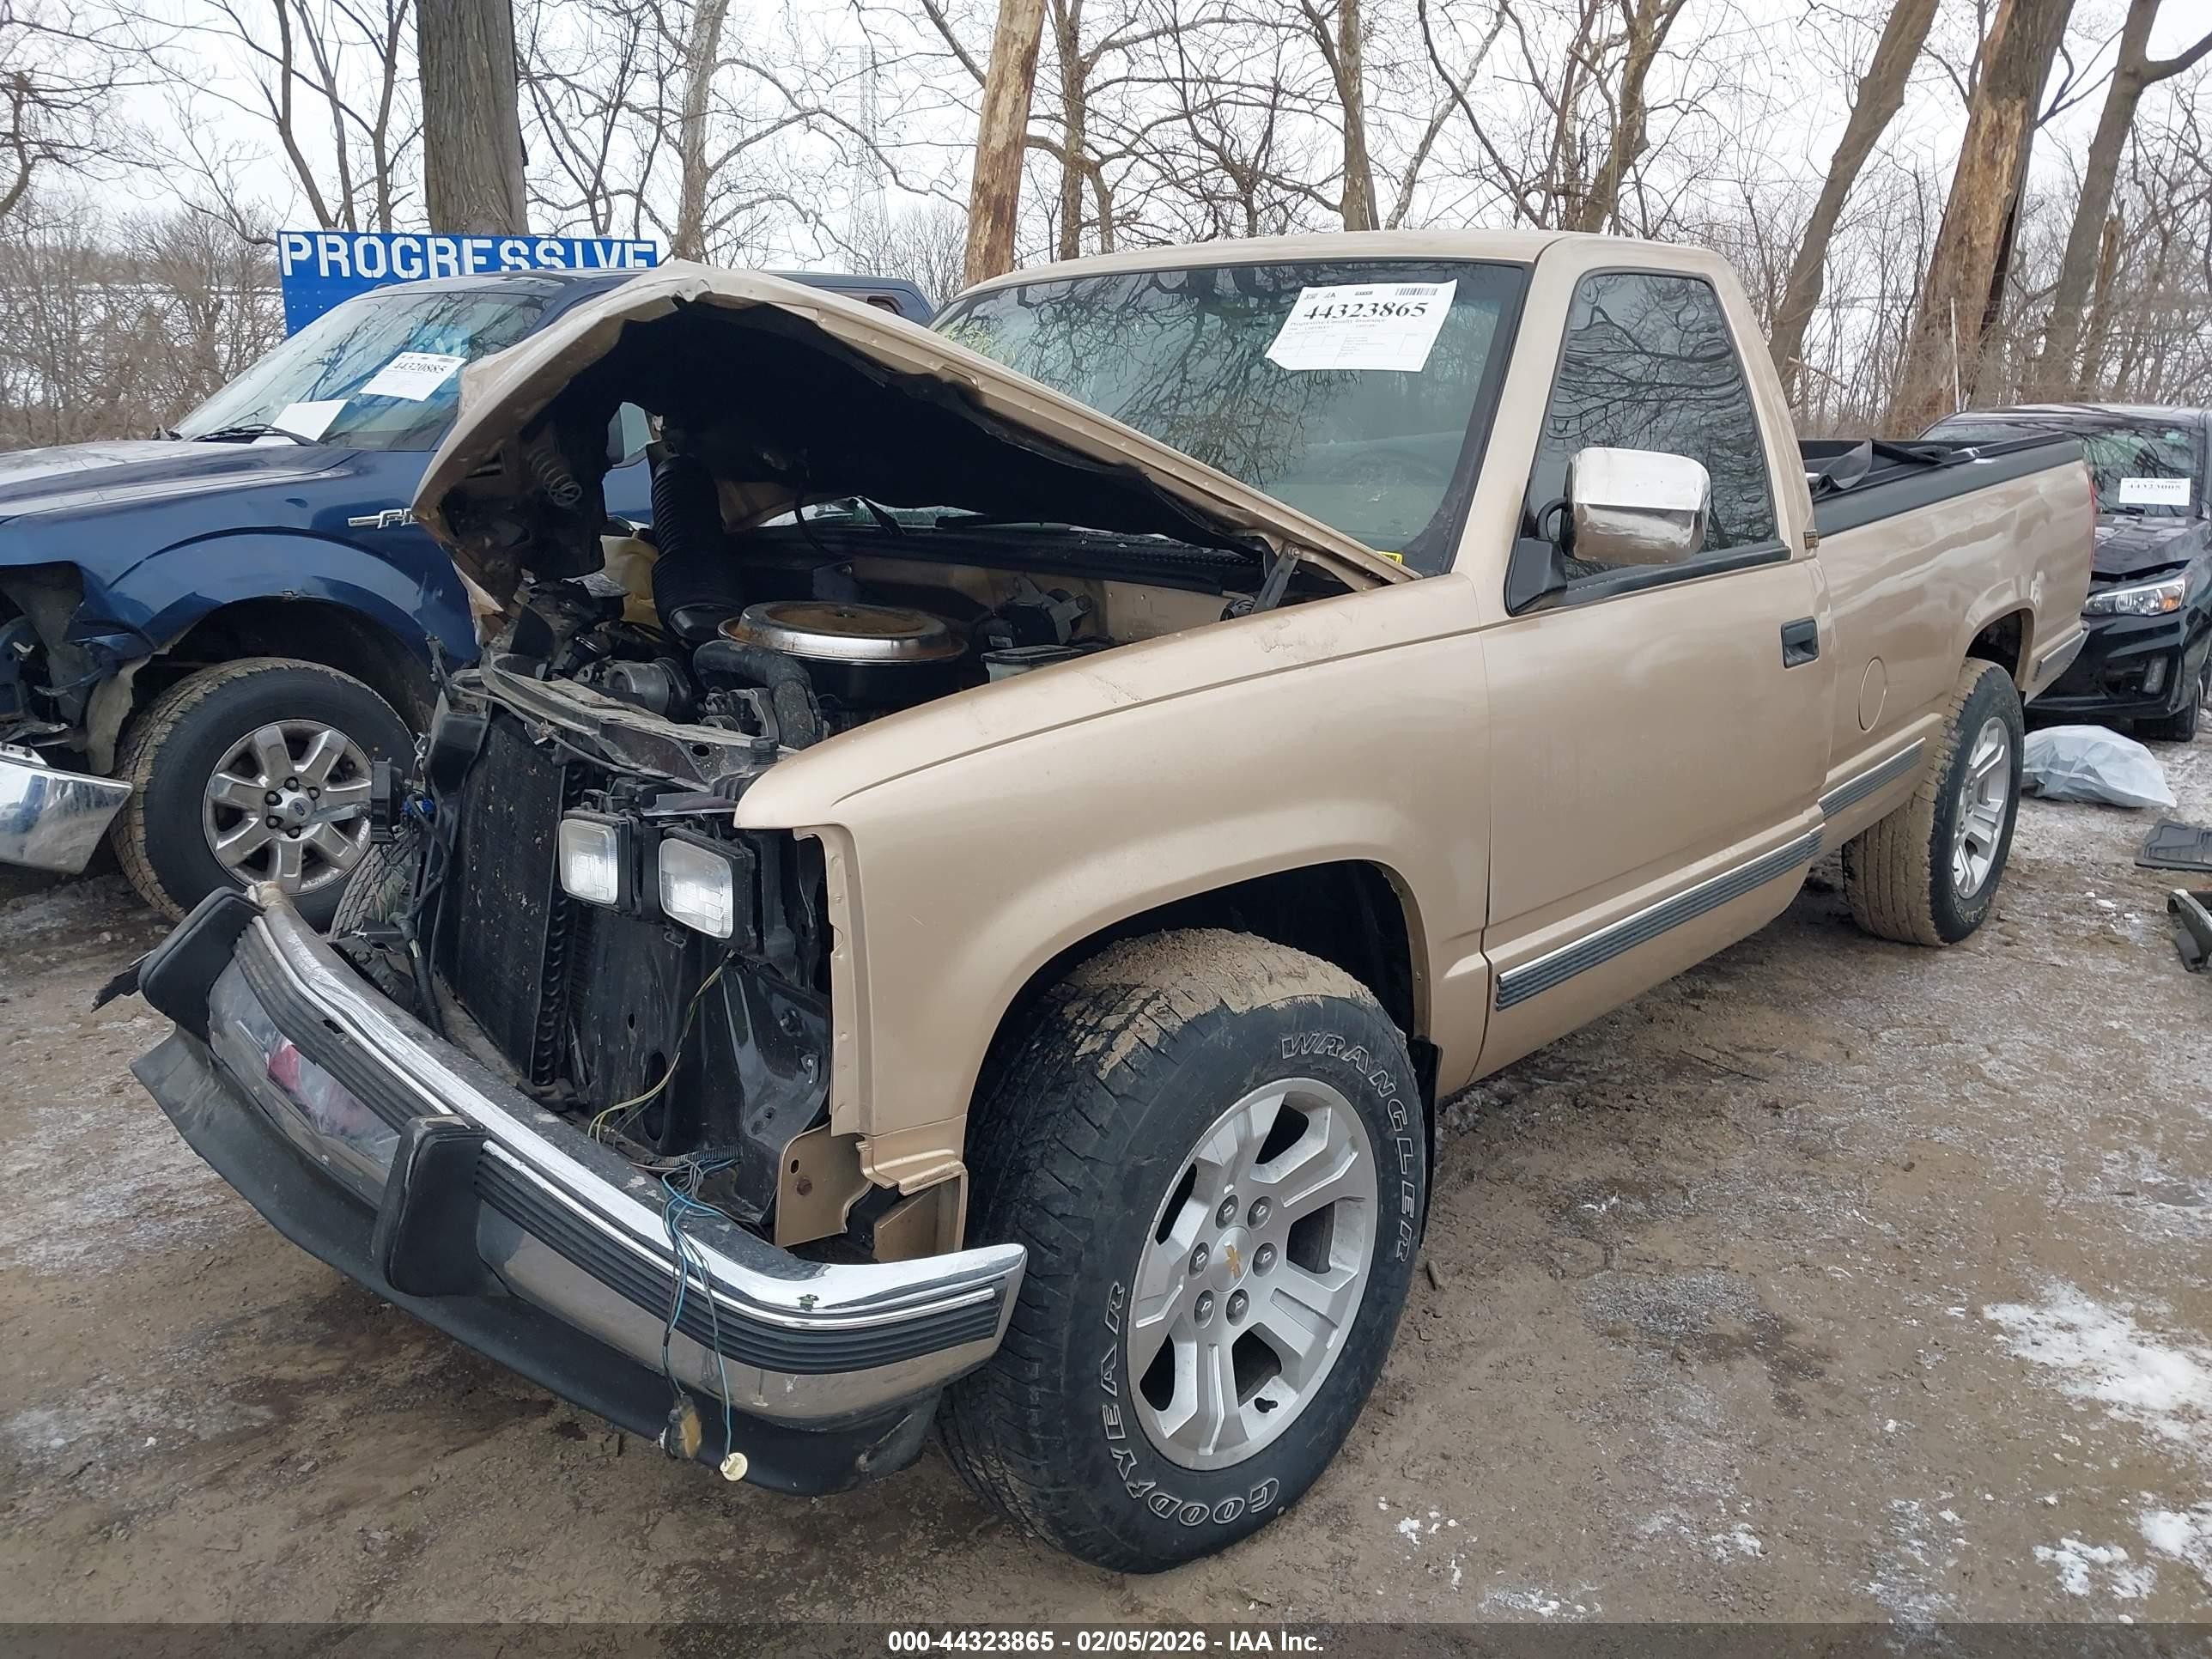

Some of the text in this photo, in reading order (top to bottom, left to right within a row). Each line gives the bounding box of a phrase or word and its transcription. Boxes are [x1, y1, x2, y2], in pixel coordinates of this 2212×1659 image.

[281, 234, 654, 279] PROGRESSIVE
[1304, 301, 1429, 319] 44323865
[1280, 1032, 1416, 1263] WRANGLER
[1099, 1280, 1280, 1527] GOODYEAR
